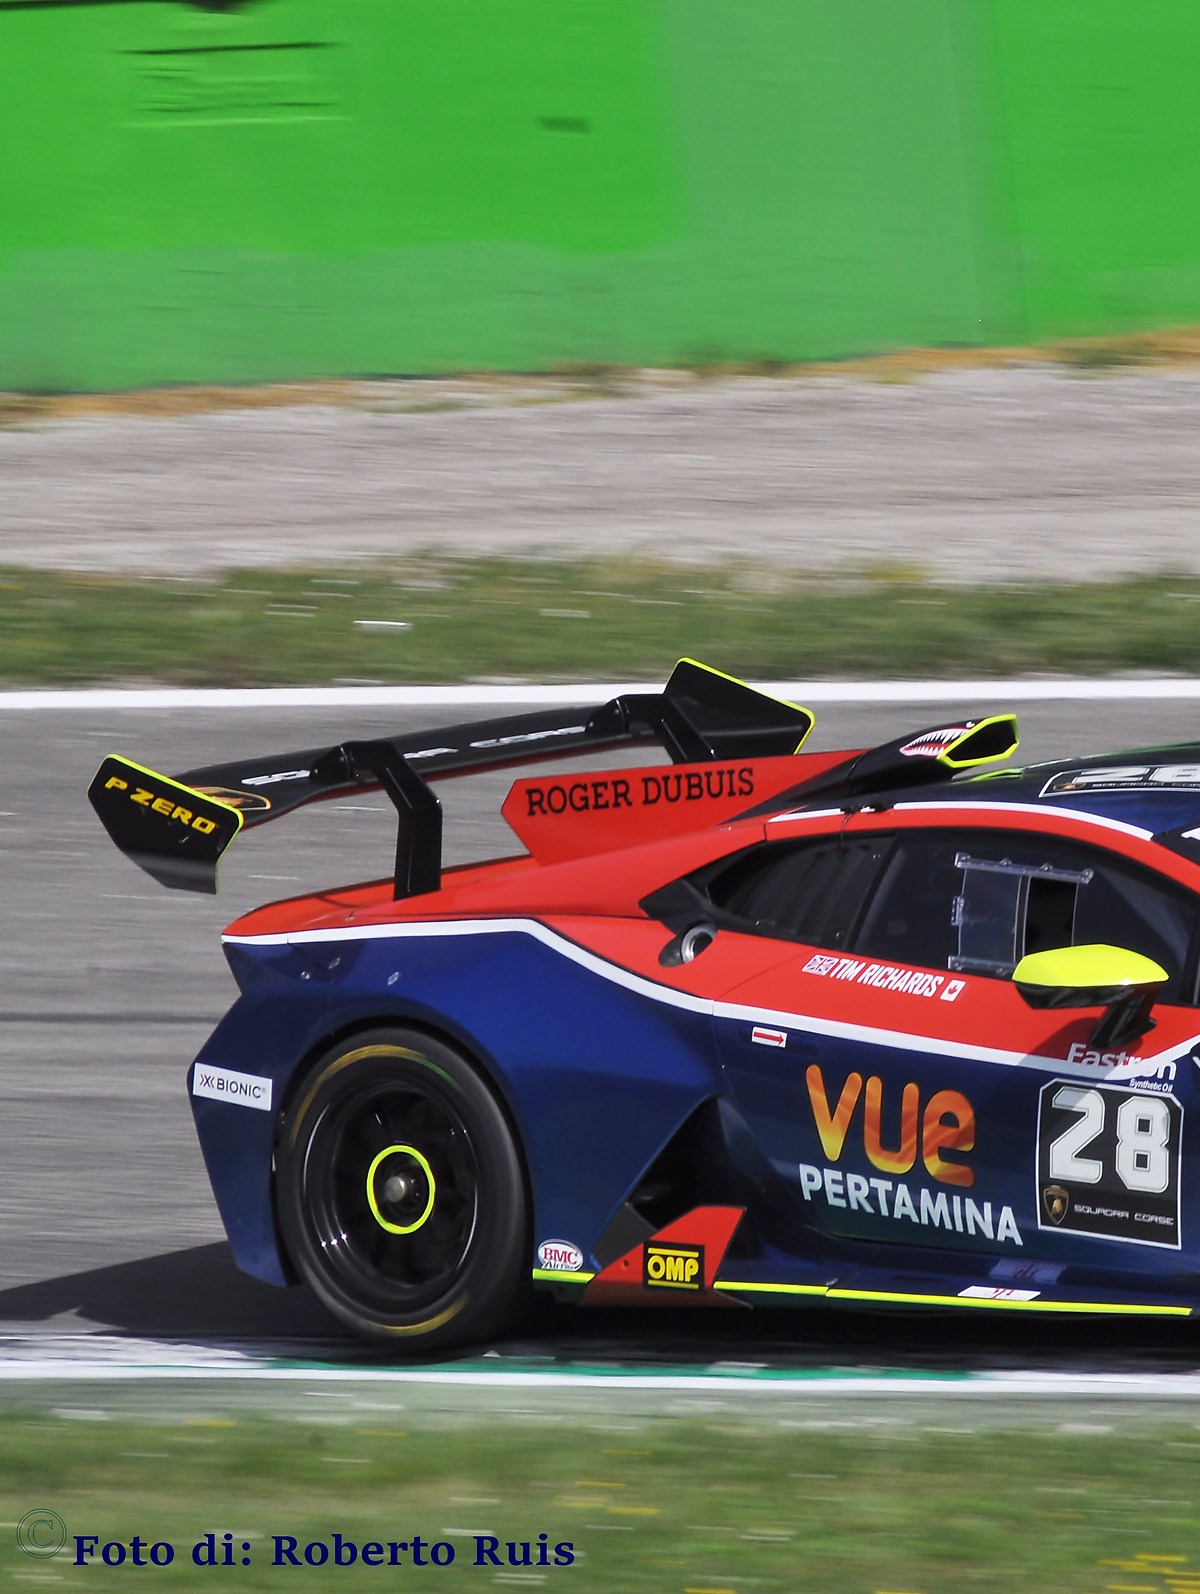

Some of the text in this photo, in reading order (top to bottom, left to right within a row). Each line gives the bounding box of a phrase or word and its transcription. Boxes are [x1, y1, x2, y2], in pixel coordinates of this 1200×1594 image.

[104, 775, 218, 835] P ZERO
[526, 767, 755, 817] ROGER DUBUIS
[829, 958, 945, 998] TIM RICHARDS
[1129, 1077, 1174, 1093] Synthetic Oil
[1049, 1085, 1171, 1195] 28
[799, 1163, 1024, 1247] PERTAMINA
[1073, 1204, 1175, 1226] SQUADRA CORSE
[543, 1247, 579, 1265] BMC
[647, 1254, 700, 1283] OMP
